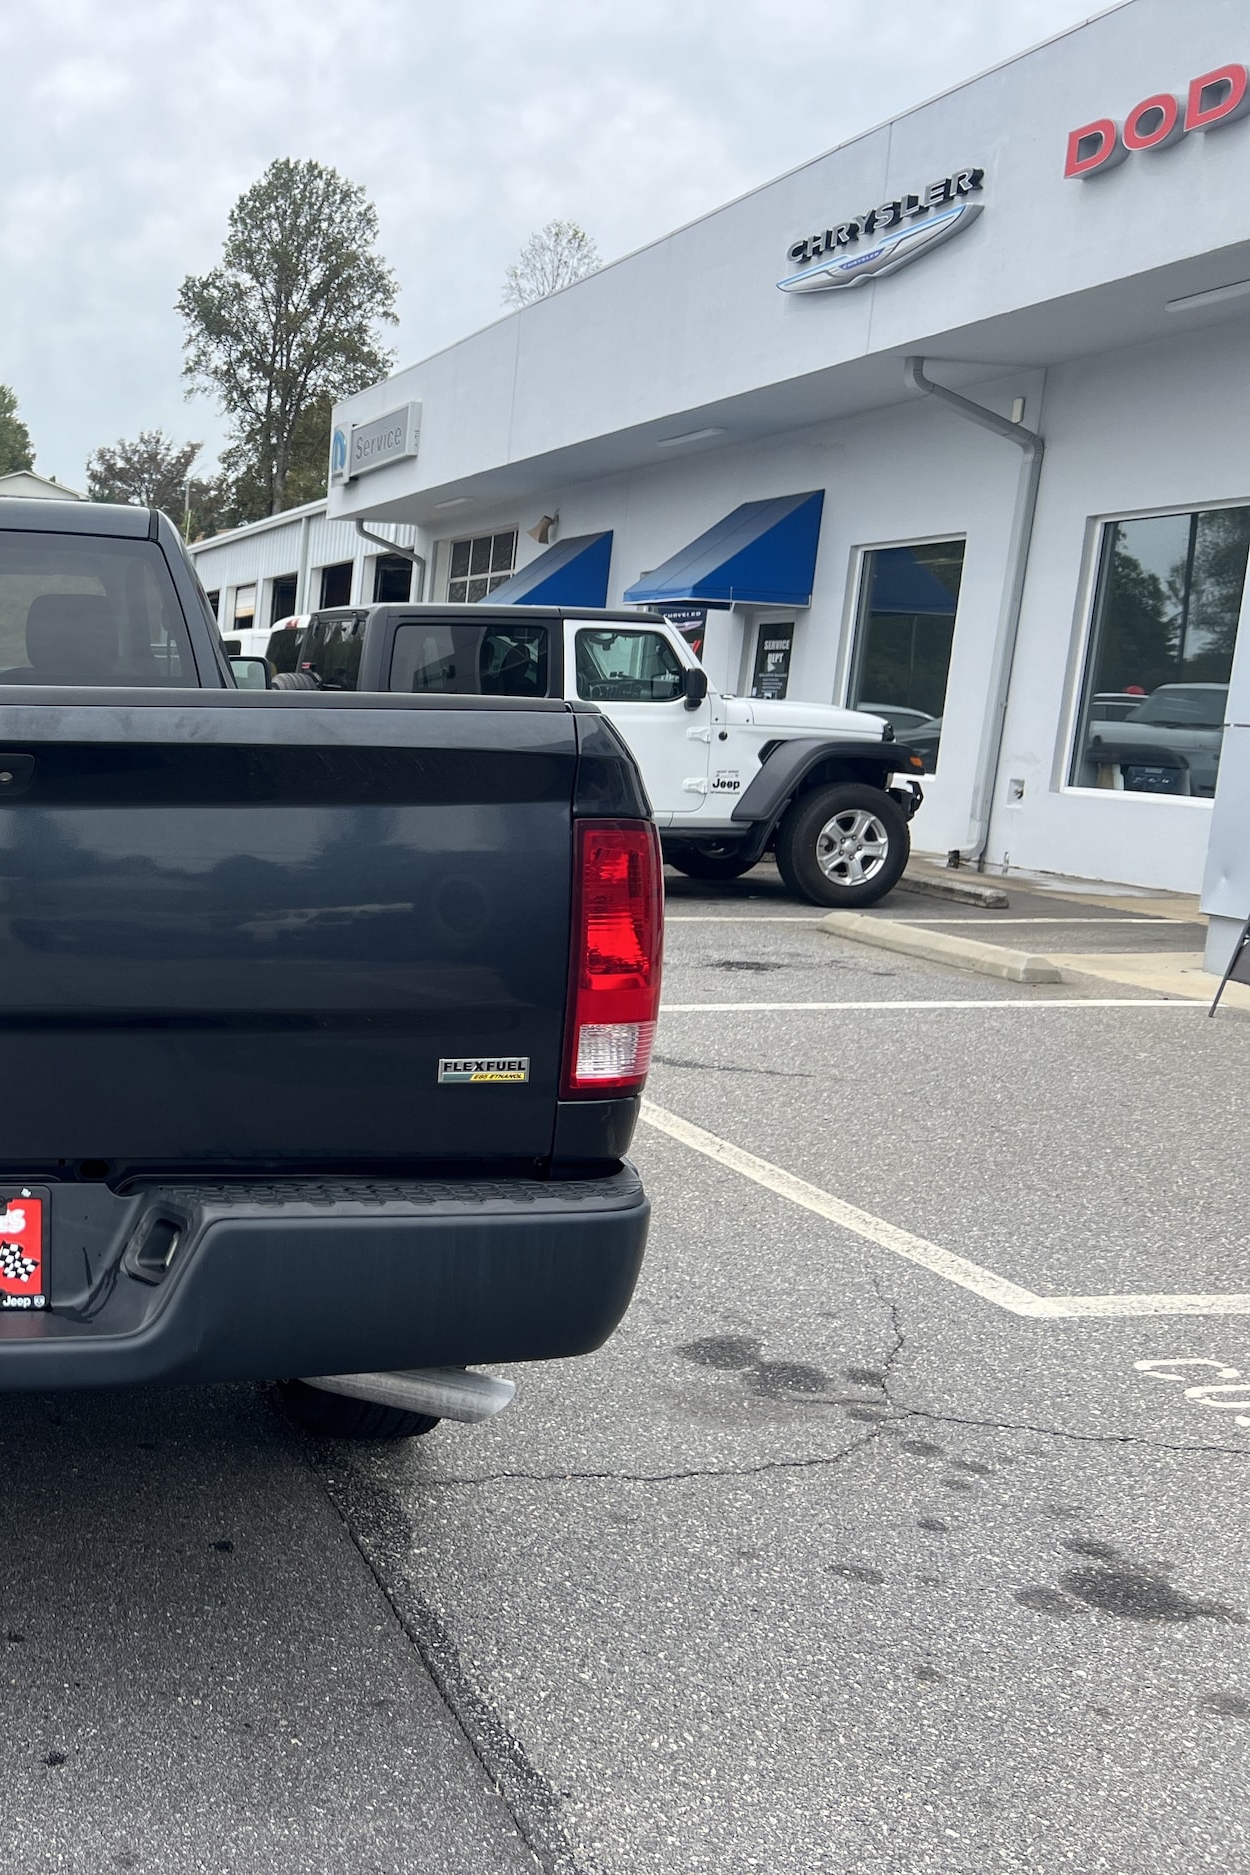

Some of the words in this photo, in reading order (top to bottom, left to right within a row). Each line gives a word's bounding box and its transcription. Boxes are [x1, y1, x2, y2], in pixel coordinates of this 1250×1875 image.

[786, 167, 983, 264] CHRYSLER
[356, 427, 402, 460] Service
[764, 640, 790, 650] SERVICE
[712, 778, 740, 790] Jeep
[444, 1061, 526, 1071] FLEXFUEL
[2, 1295, 32, 1308] Jeep
